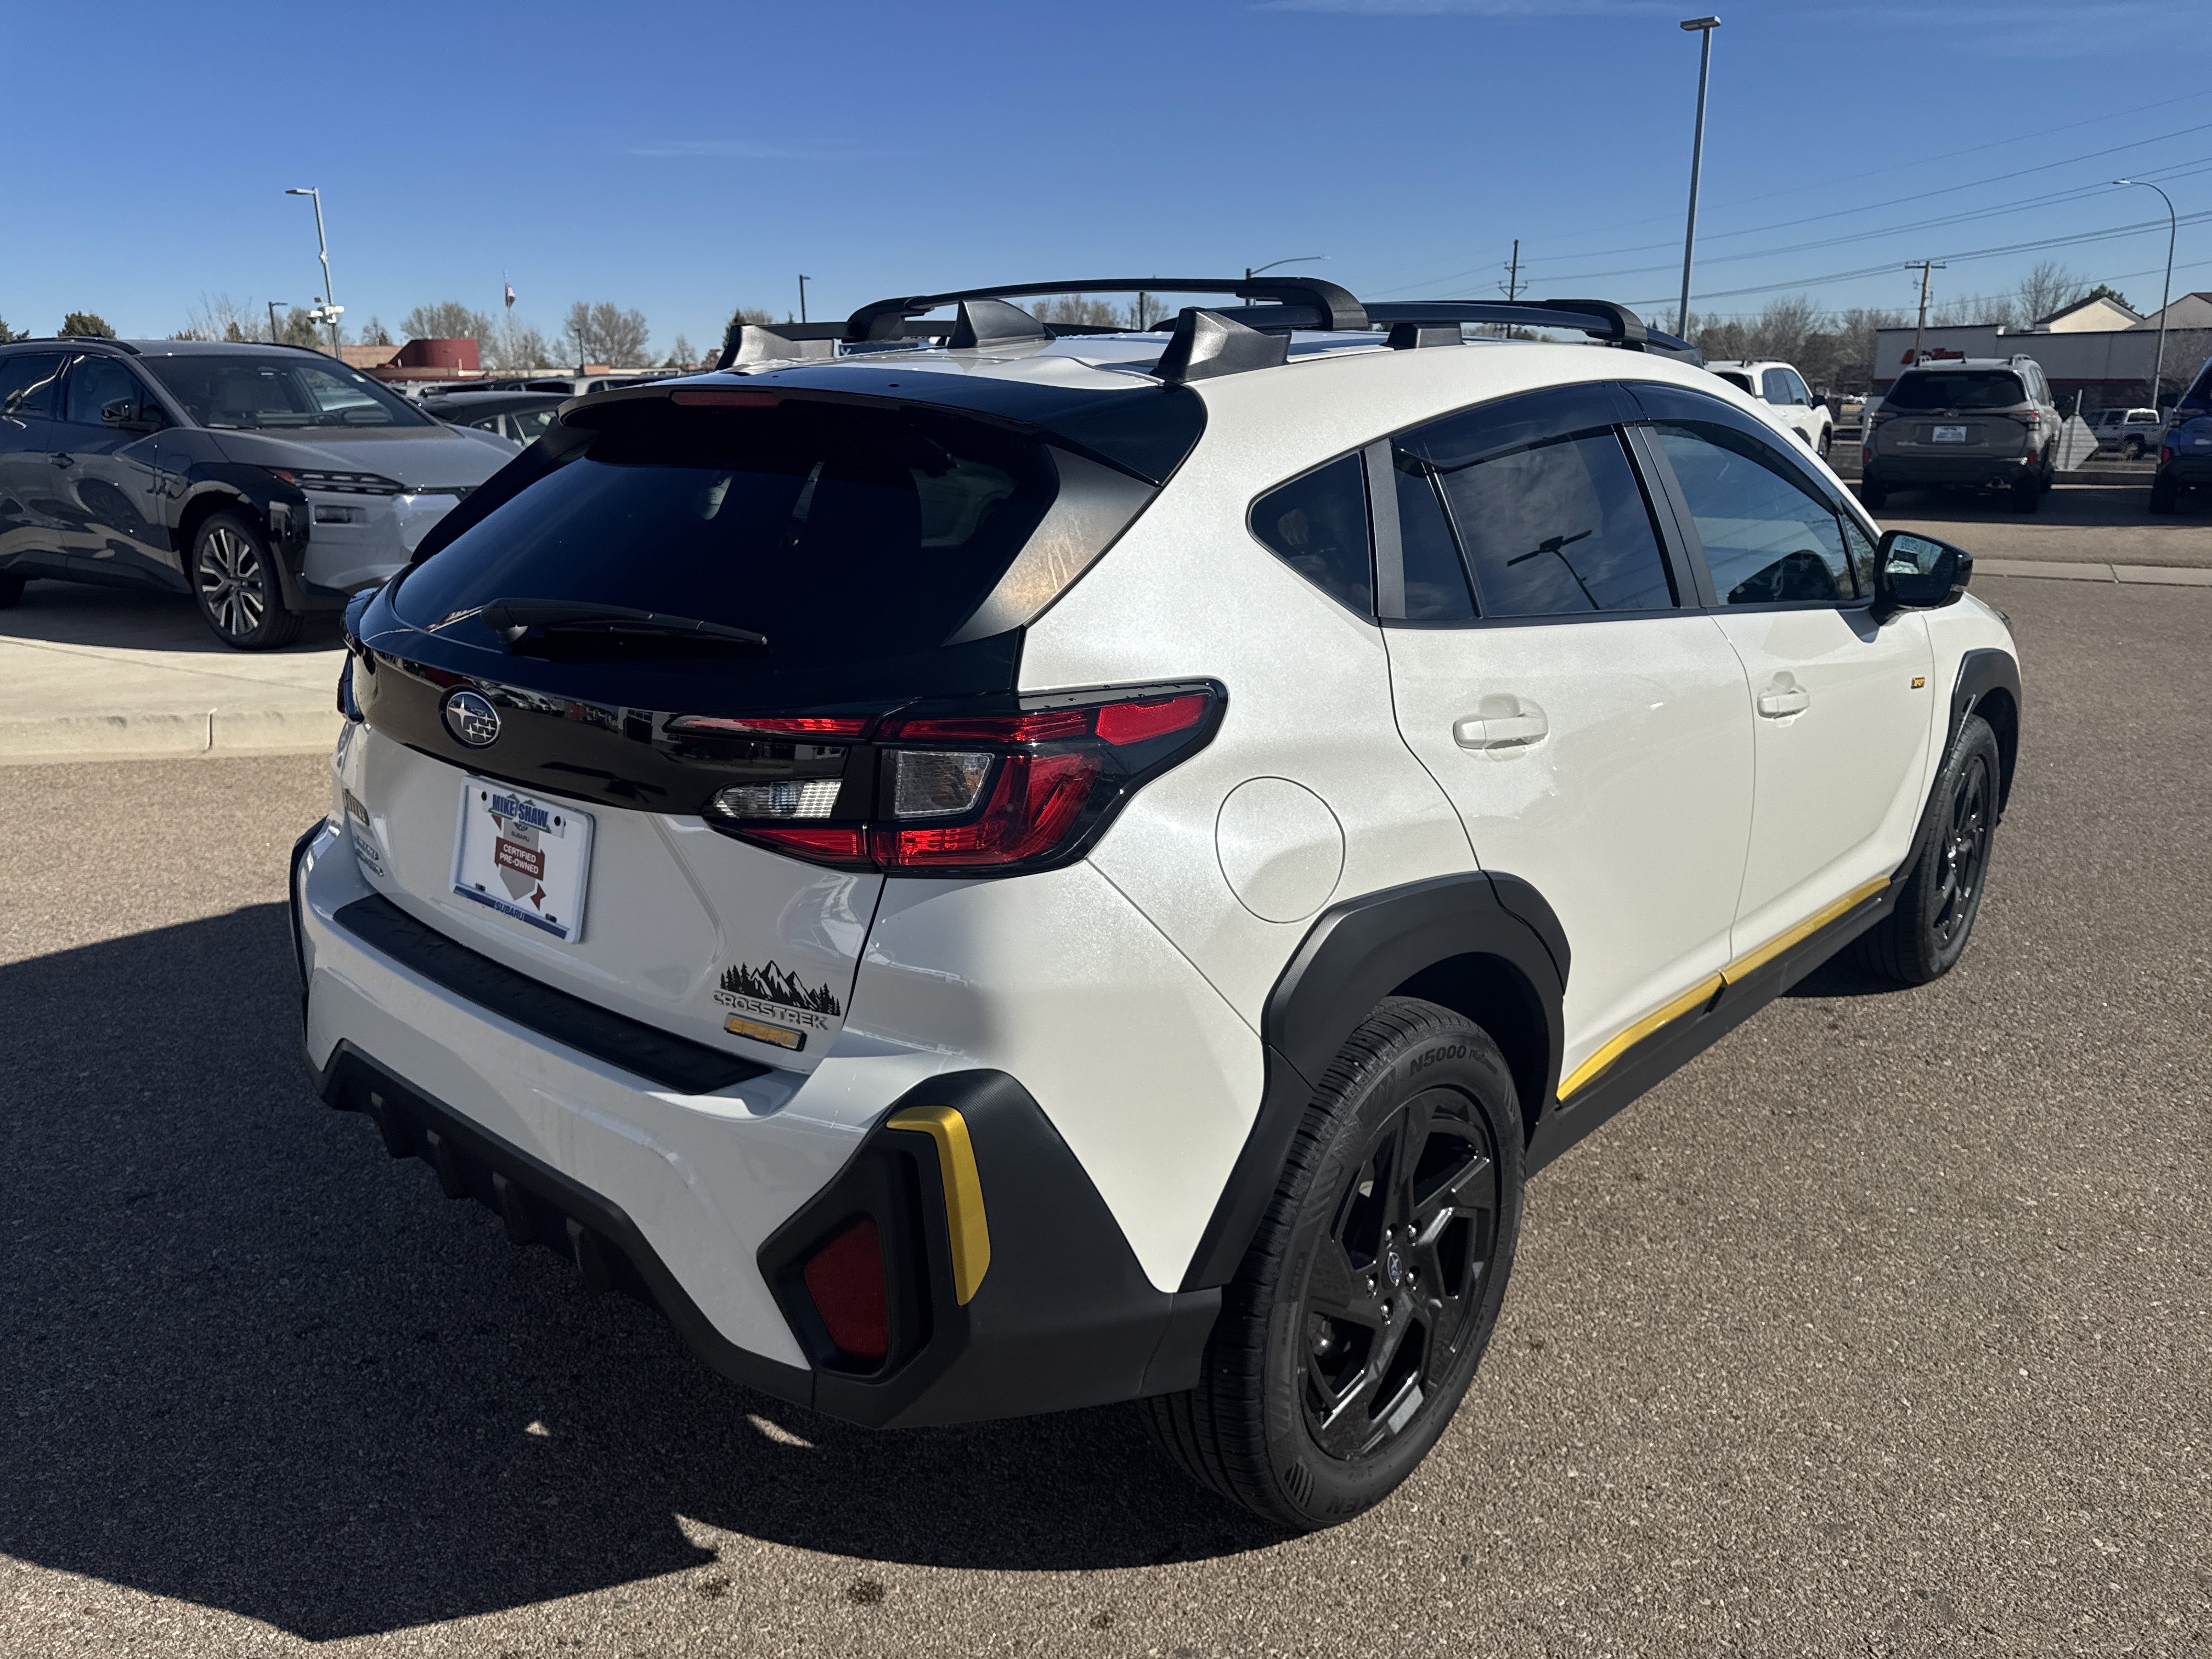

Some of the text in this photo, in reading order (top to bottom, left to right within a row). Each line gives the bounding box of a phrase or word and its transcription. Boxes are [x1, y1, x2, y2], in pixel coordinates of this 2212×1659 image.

[492, 794, 548, 828] MIKE SHAW
[511, 830, 530, 842] SUBARU
[500, 851, 539, 874] PRE-OWNED
[503, 843, 537, 863] CERTIFIED
[495, 901, 524, 921] SUBARU
[714, 990, 828, 1031] CROSSTREK
[730, 1018, 794, 1045] SPORT
[1409, 1045, 1467, 1076] N5000
